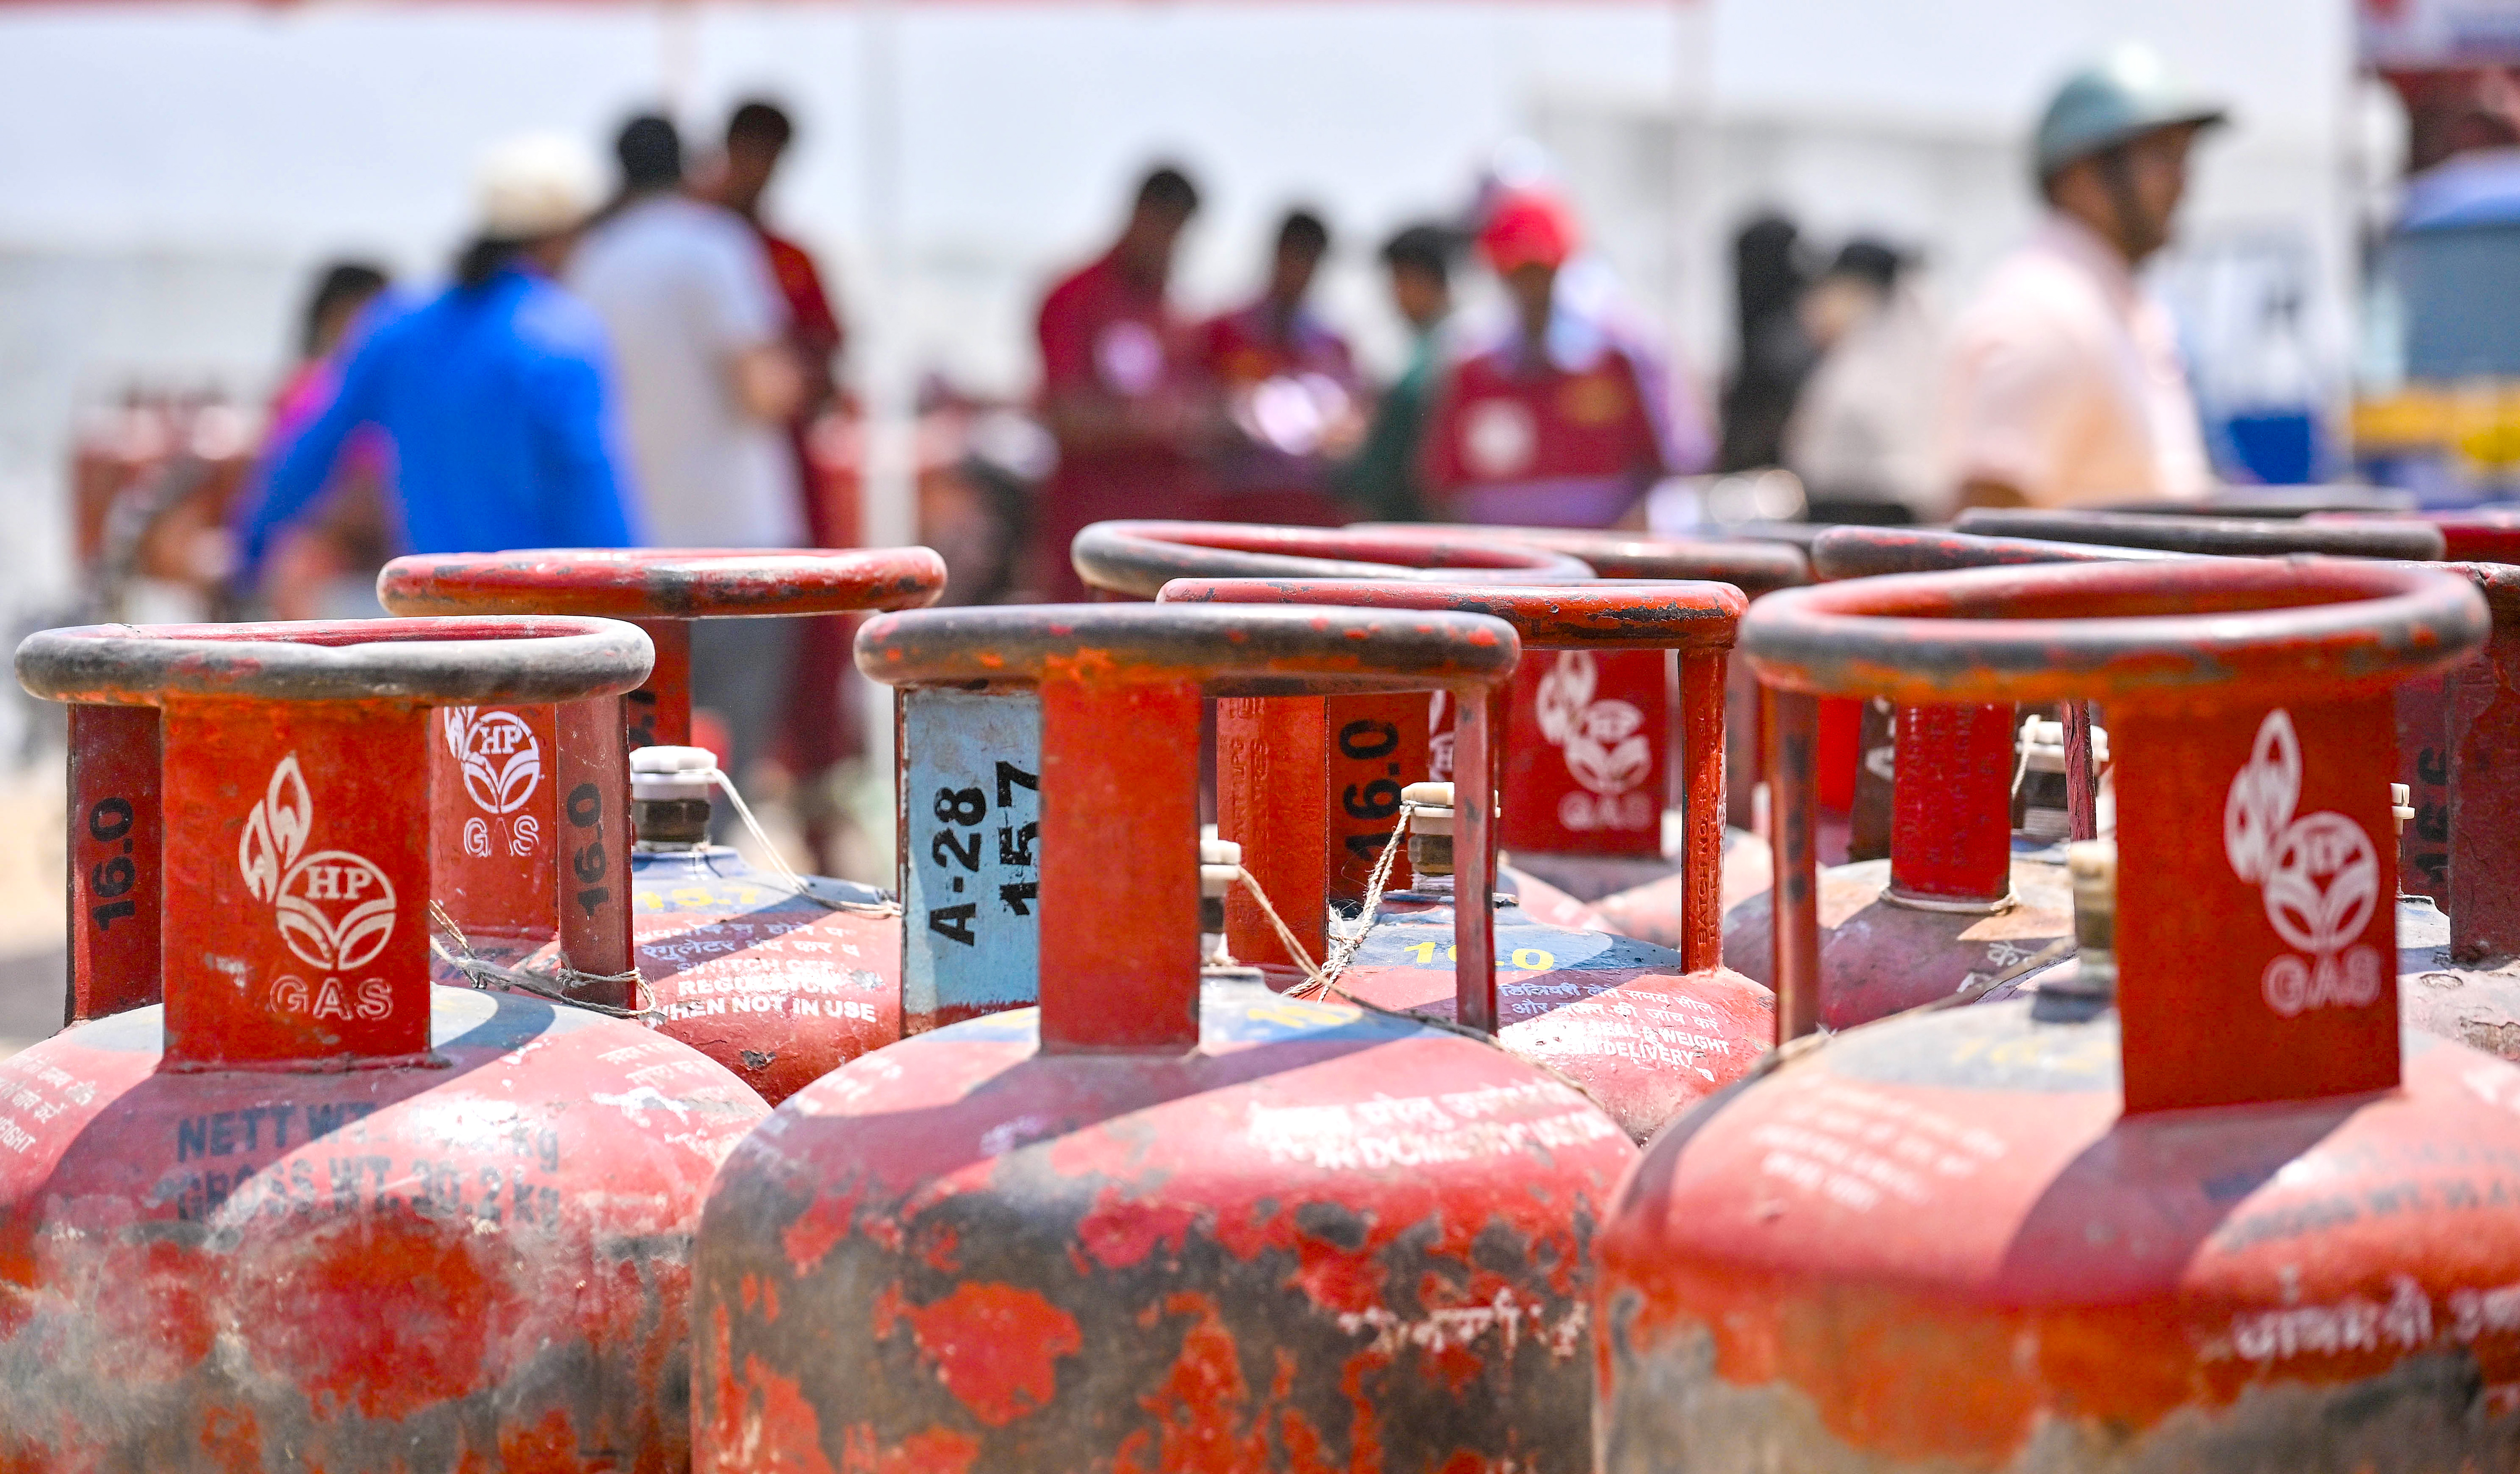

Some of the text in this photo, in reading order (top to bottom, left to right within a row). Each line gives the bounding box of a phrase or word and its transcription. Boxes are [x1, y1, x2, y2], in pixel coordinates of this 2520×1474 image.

[479, 724, 520, 755] HP
[567, 782, 609, 917] 16.0
[996, 761, 1040, 915] 157
[89, 797, 135, 931] 16.0
[929, 787, 987, 947] A-28
[304, 865, 373, 900] HP
[1403, 942, 1555, 971] 1.0
[269, 974, 394, 1021] GAS
[732, 993, 787, 1013] NOT
[792, 997, 816, 1017] IN
[823, 999, 877, 1023] USE
[1511, 998, 1550, 1015] और
[1623, 989, 1670, 1005] समय
[1672, 995, 1716, 1015] सील
[1603, 1040, 1694, 1069] DELIVERY
[1657, 1027, 1730, 1055] WEIGHT
[177, 1105, 296, 1163] NETT
